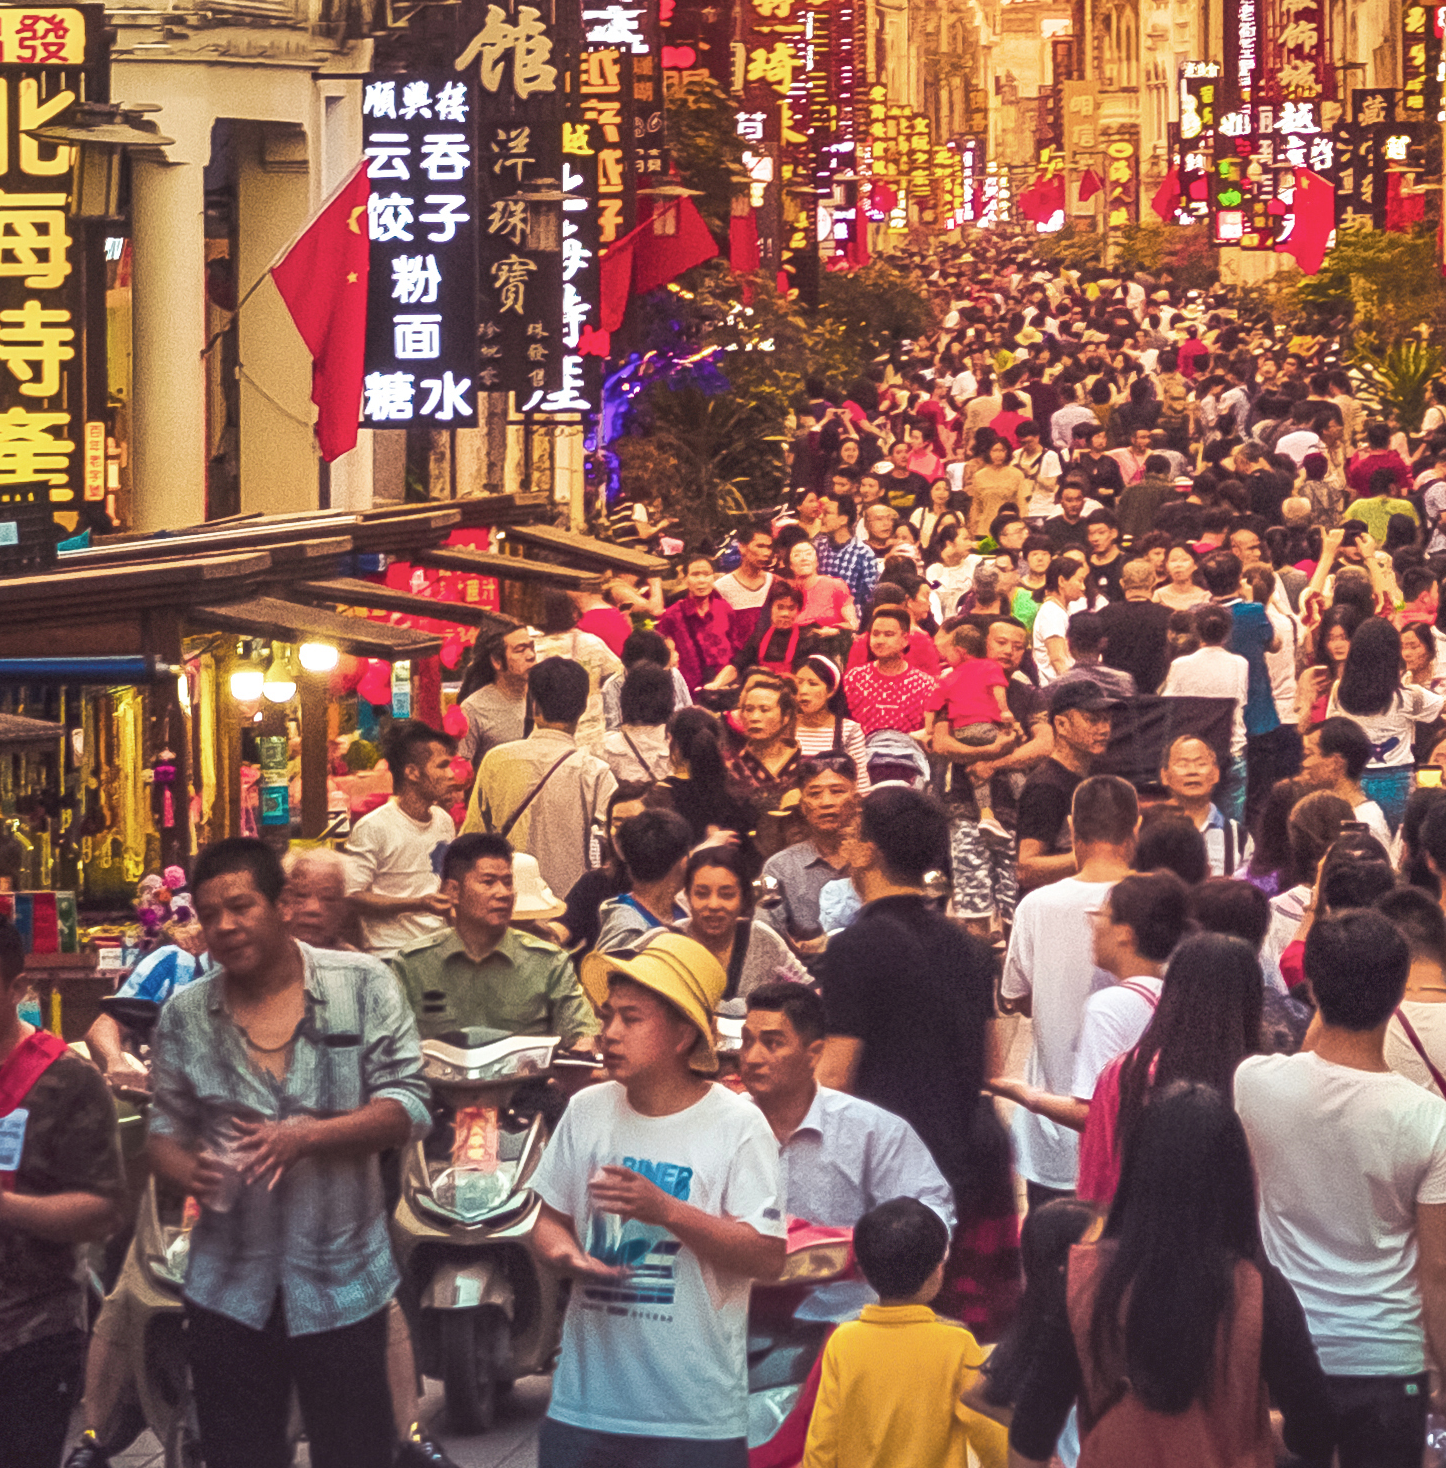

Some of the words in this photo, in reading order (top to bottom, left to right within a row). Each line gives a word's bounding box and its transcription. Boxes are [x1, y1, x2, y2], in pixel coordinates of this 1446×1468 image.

[364, 133, 470, 182] 云吞
[366, 193, 470, 243] 饺子
[391, 253, 441, 304] 粉
[393, 314, 441, 360] 面
[363, 372, 473, 421] 糖水
